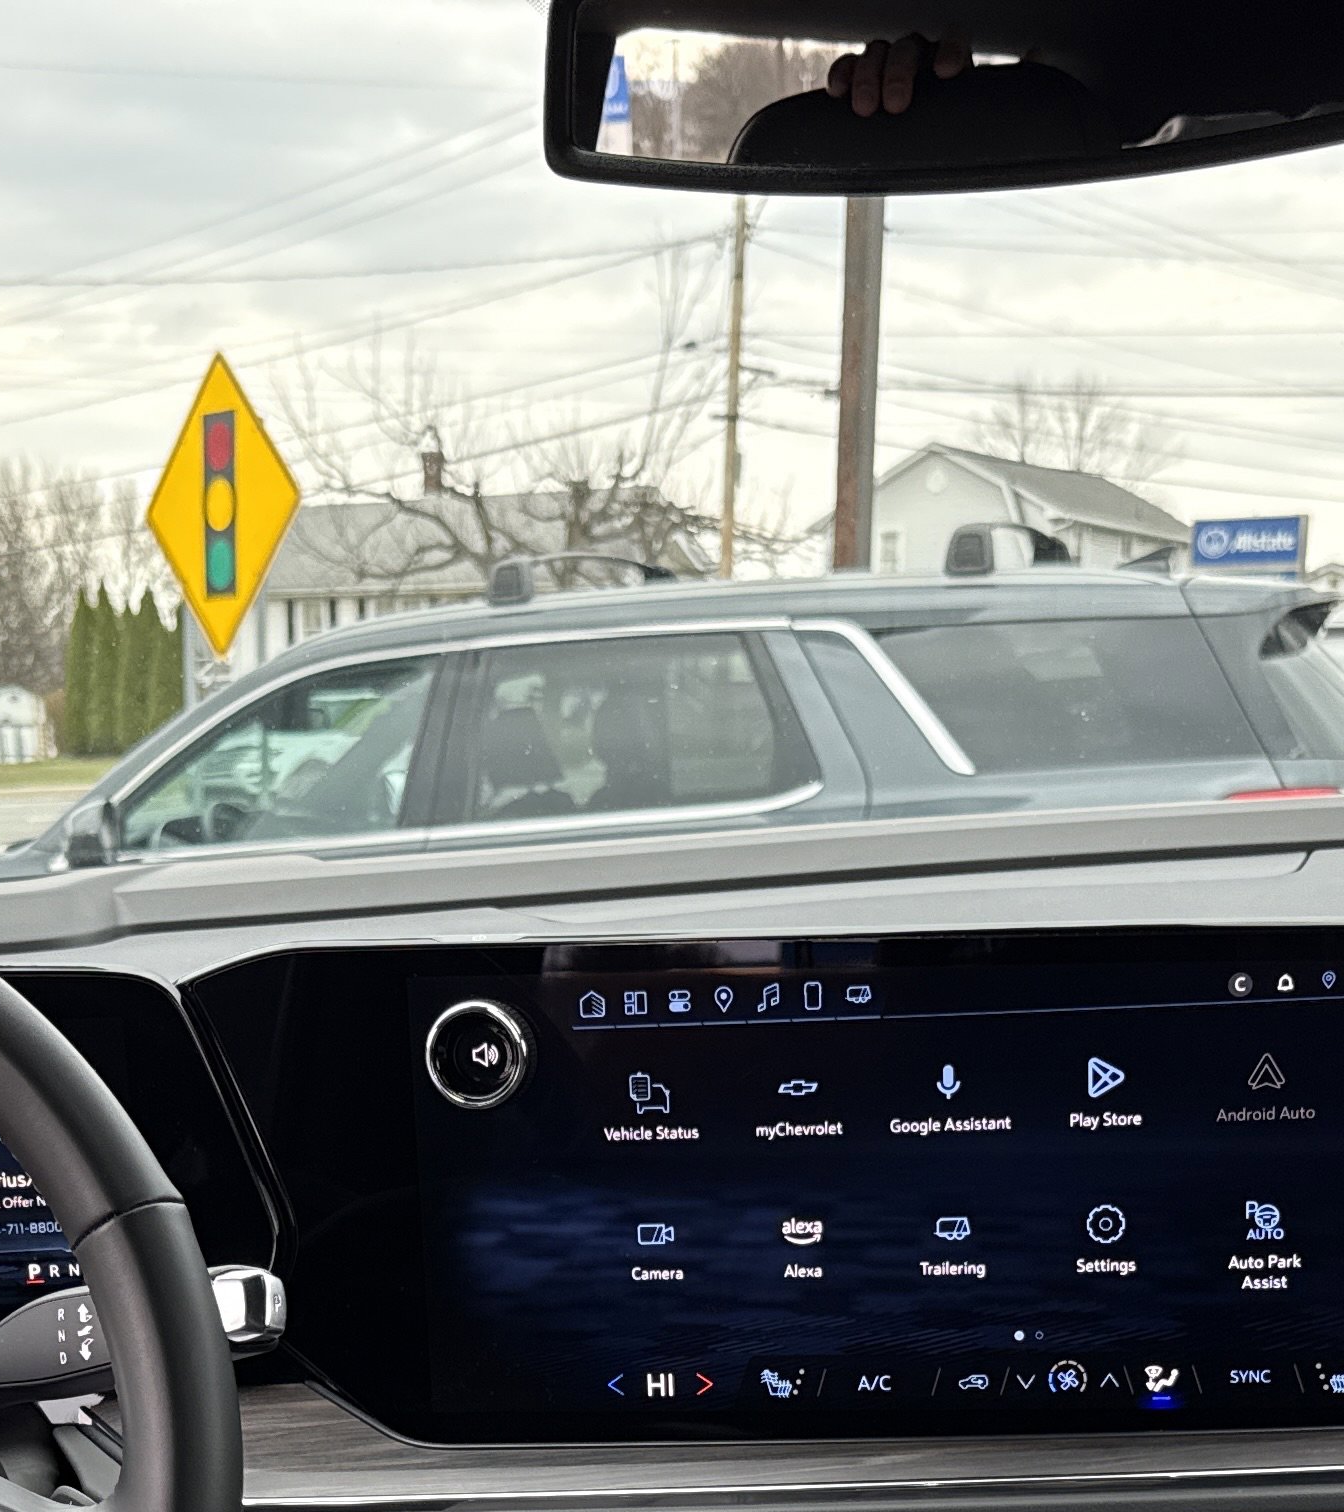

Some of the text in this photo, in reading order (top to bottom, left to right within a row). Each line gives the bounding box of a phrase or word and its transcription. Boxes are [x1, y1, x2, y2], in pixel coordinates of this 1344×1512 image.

[1230, 527, 1297, 554] Allstate
[1069, 1111, 1142, 1131] Play Store
[1216, 1104, 1316, 1122] Android Auto
[604, 1126, 700, 1142] Vehicle Status
[755, 1121, 844, 1140] myChevrolet
[889, 1116, 1012, 1136] Google Assistant
[2, 1195, 33, 1209] Offer
[781, 1218, 823, 1235] alexa
[1245, 1227, 1285, 1240] AUTO
[919, 1260, 986, 1278] Trailering
[1076, 1256, 1136, 1276] Settings
[1228, 1252, 1302, 1270] Auto Park
[27, 1263, 81, 1280] P R N
[631, 1267, 684, 1282] Camera
[783, 1264, 823, 1279] Alexa
[1241, 1274, 1288, 1290] Assist
[57, 1308, 65, 1321] R
[57, 1329, 66, 1343] N
[59, 1351, 68, 1365] D
[646, 1373, 675, 1398] HI
[857, 1374, 892, 1394] A/C
[1229, 1369, 1272, 1385] SYNC
